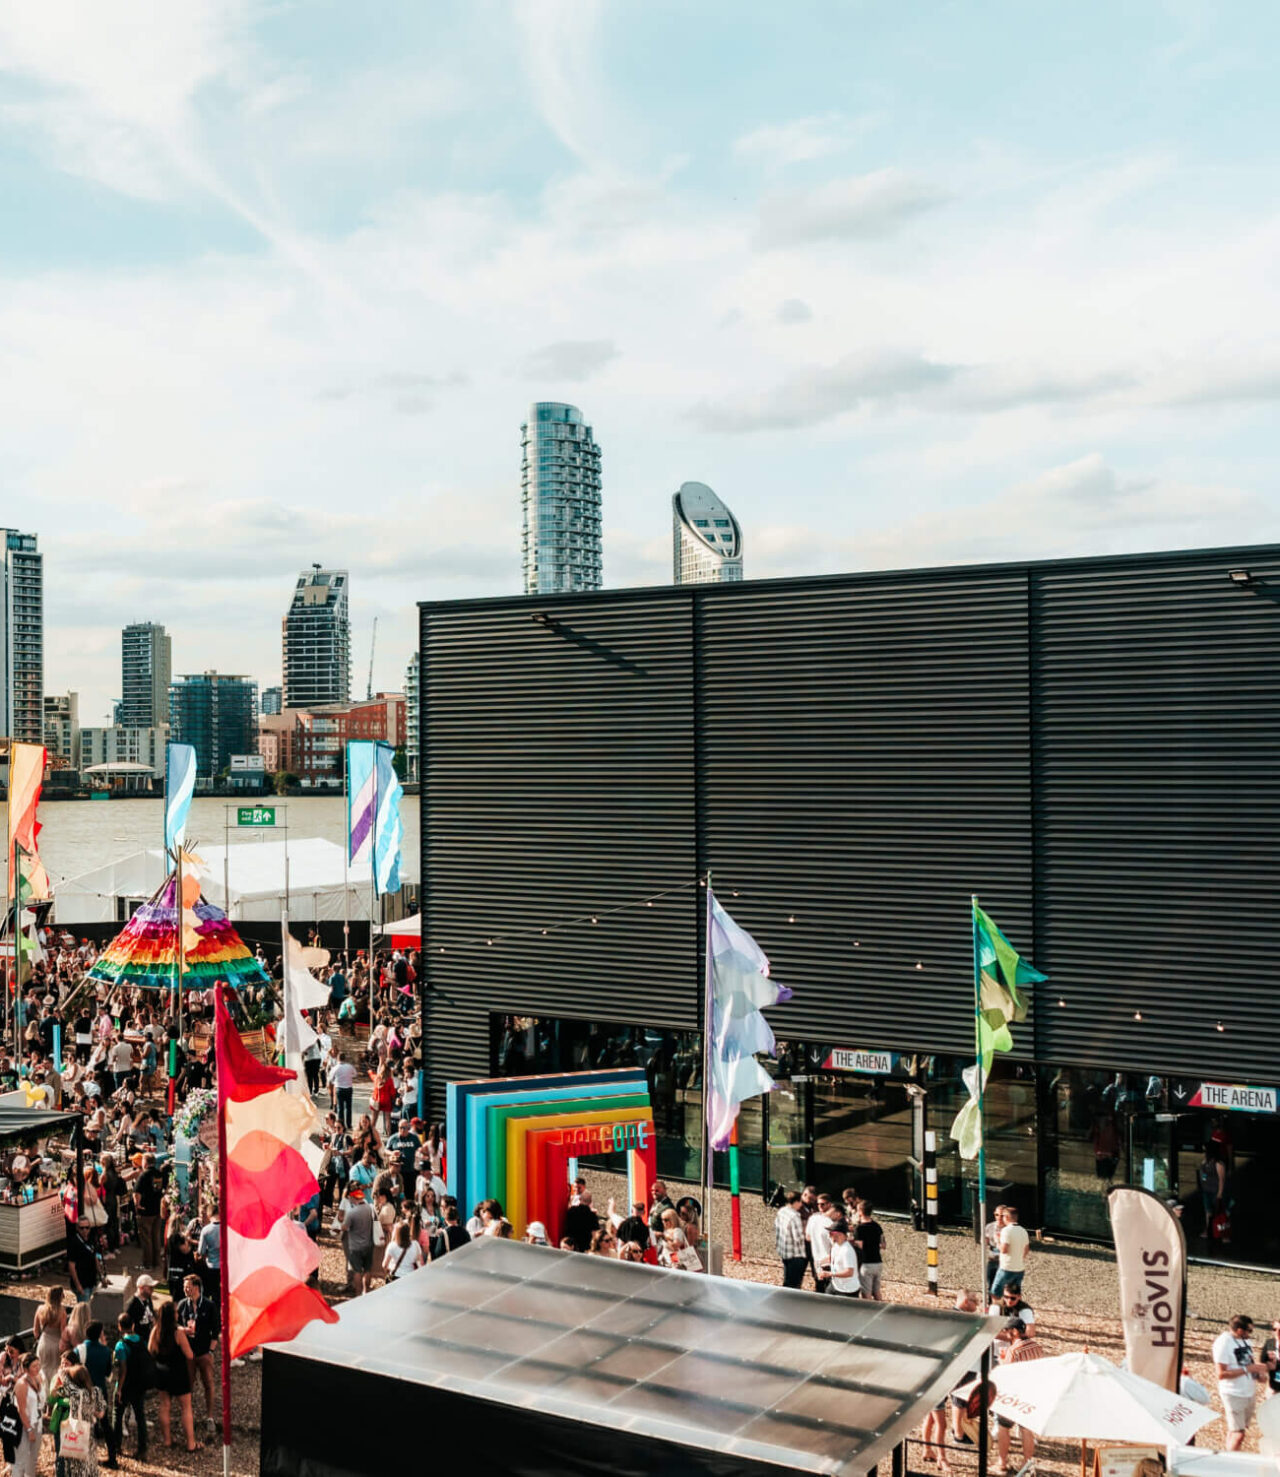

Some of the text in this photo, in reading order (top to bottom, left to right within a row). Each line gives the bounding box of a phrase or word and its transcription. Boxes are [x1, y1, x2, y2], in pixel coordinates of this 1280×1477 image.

[833, 1051, 889, 1070] THE ARENA
[1204, 1086, 1273, 1108] THE ARENA
[1142, 1250, 1176, 1348] HOVIS
